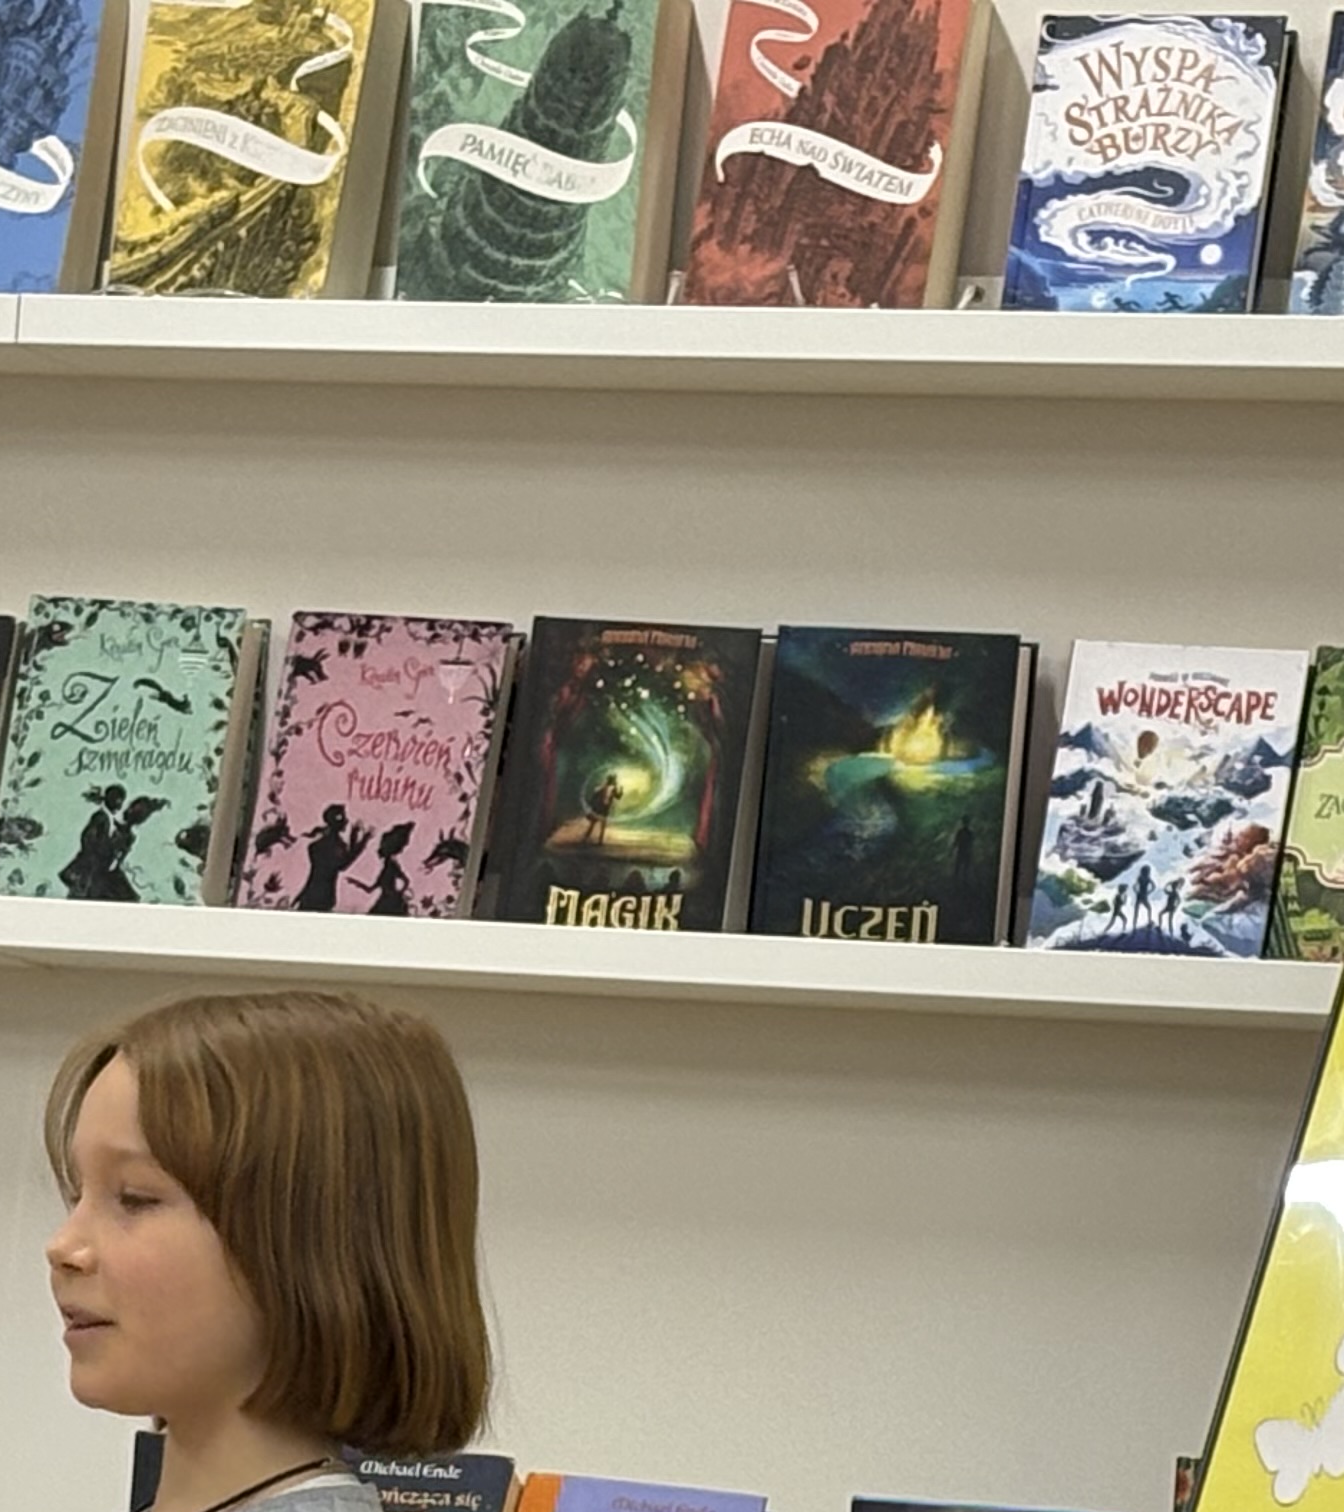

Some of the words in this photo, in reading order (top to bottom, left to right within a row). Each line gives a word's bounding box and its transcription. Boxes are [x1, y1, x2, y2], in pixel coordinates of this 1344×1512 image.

[1073, 40, 1239, 97] WYSPA
[1064, 84, 1245, 147] STRAŻNIKA
[748, 127, 793, 149] ECHA
[797, 140, 829, 164] NAD
[828, 150, 914, 198] ŚWIATEM
[1084, 122, 1222, 165] BURZY
[1096, 680, 1279, 727] WONDERSCAPE
[63, 727, 195, 785] szmaragdu
[317, 700, 454, 780] Czerwień
[346, 761, 435, 811] rubinu
[359, 1460, 422, 1478] Michael
[422, 1462, 463, 1480] Ende
[379, 1486, 451, 1509] ończąca
